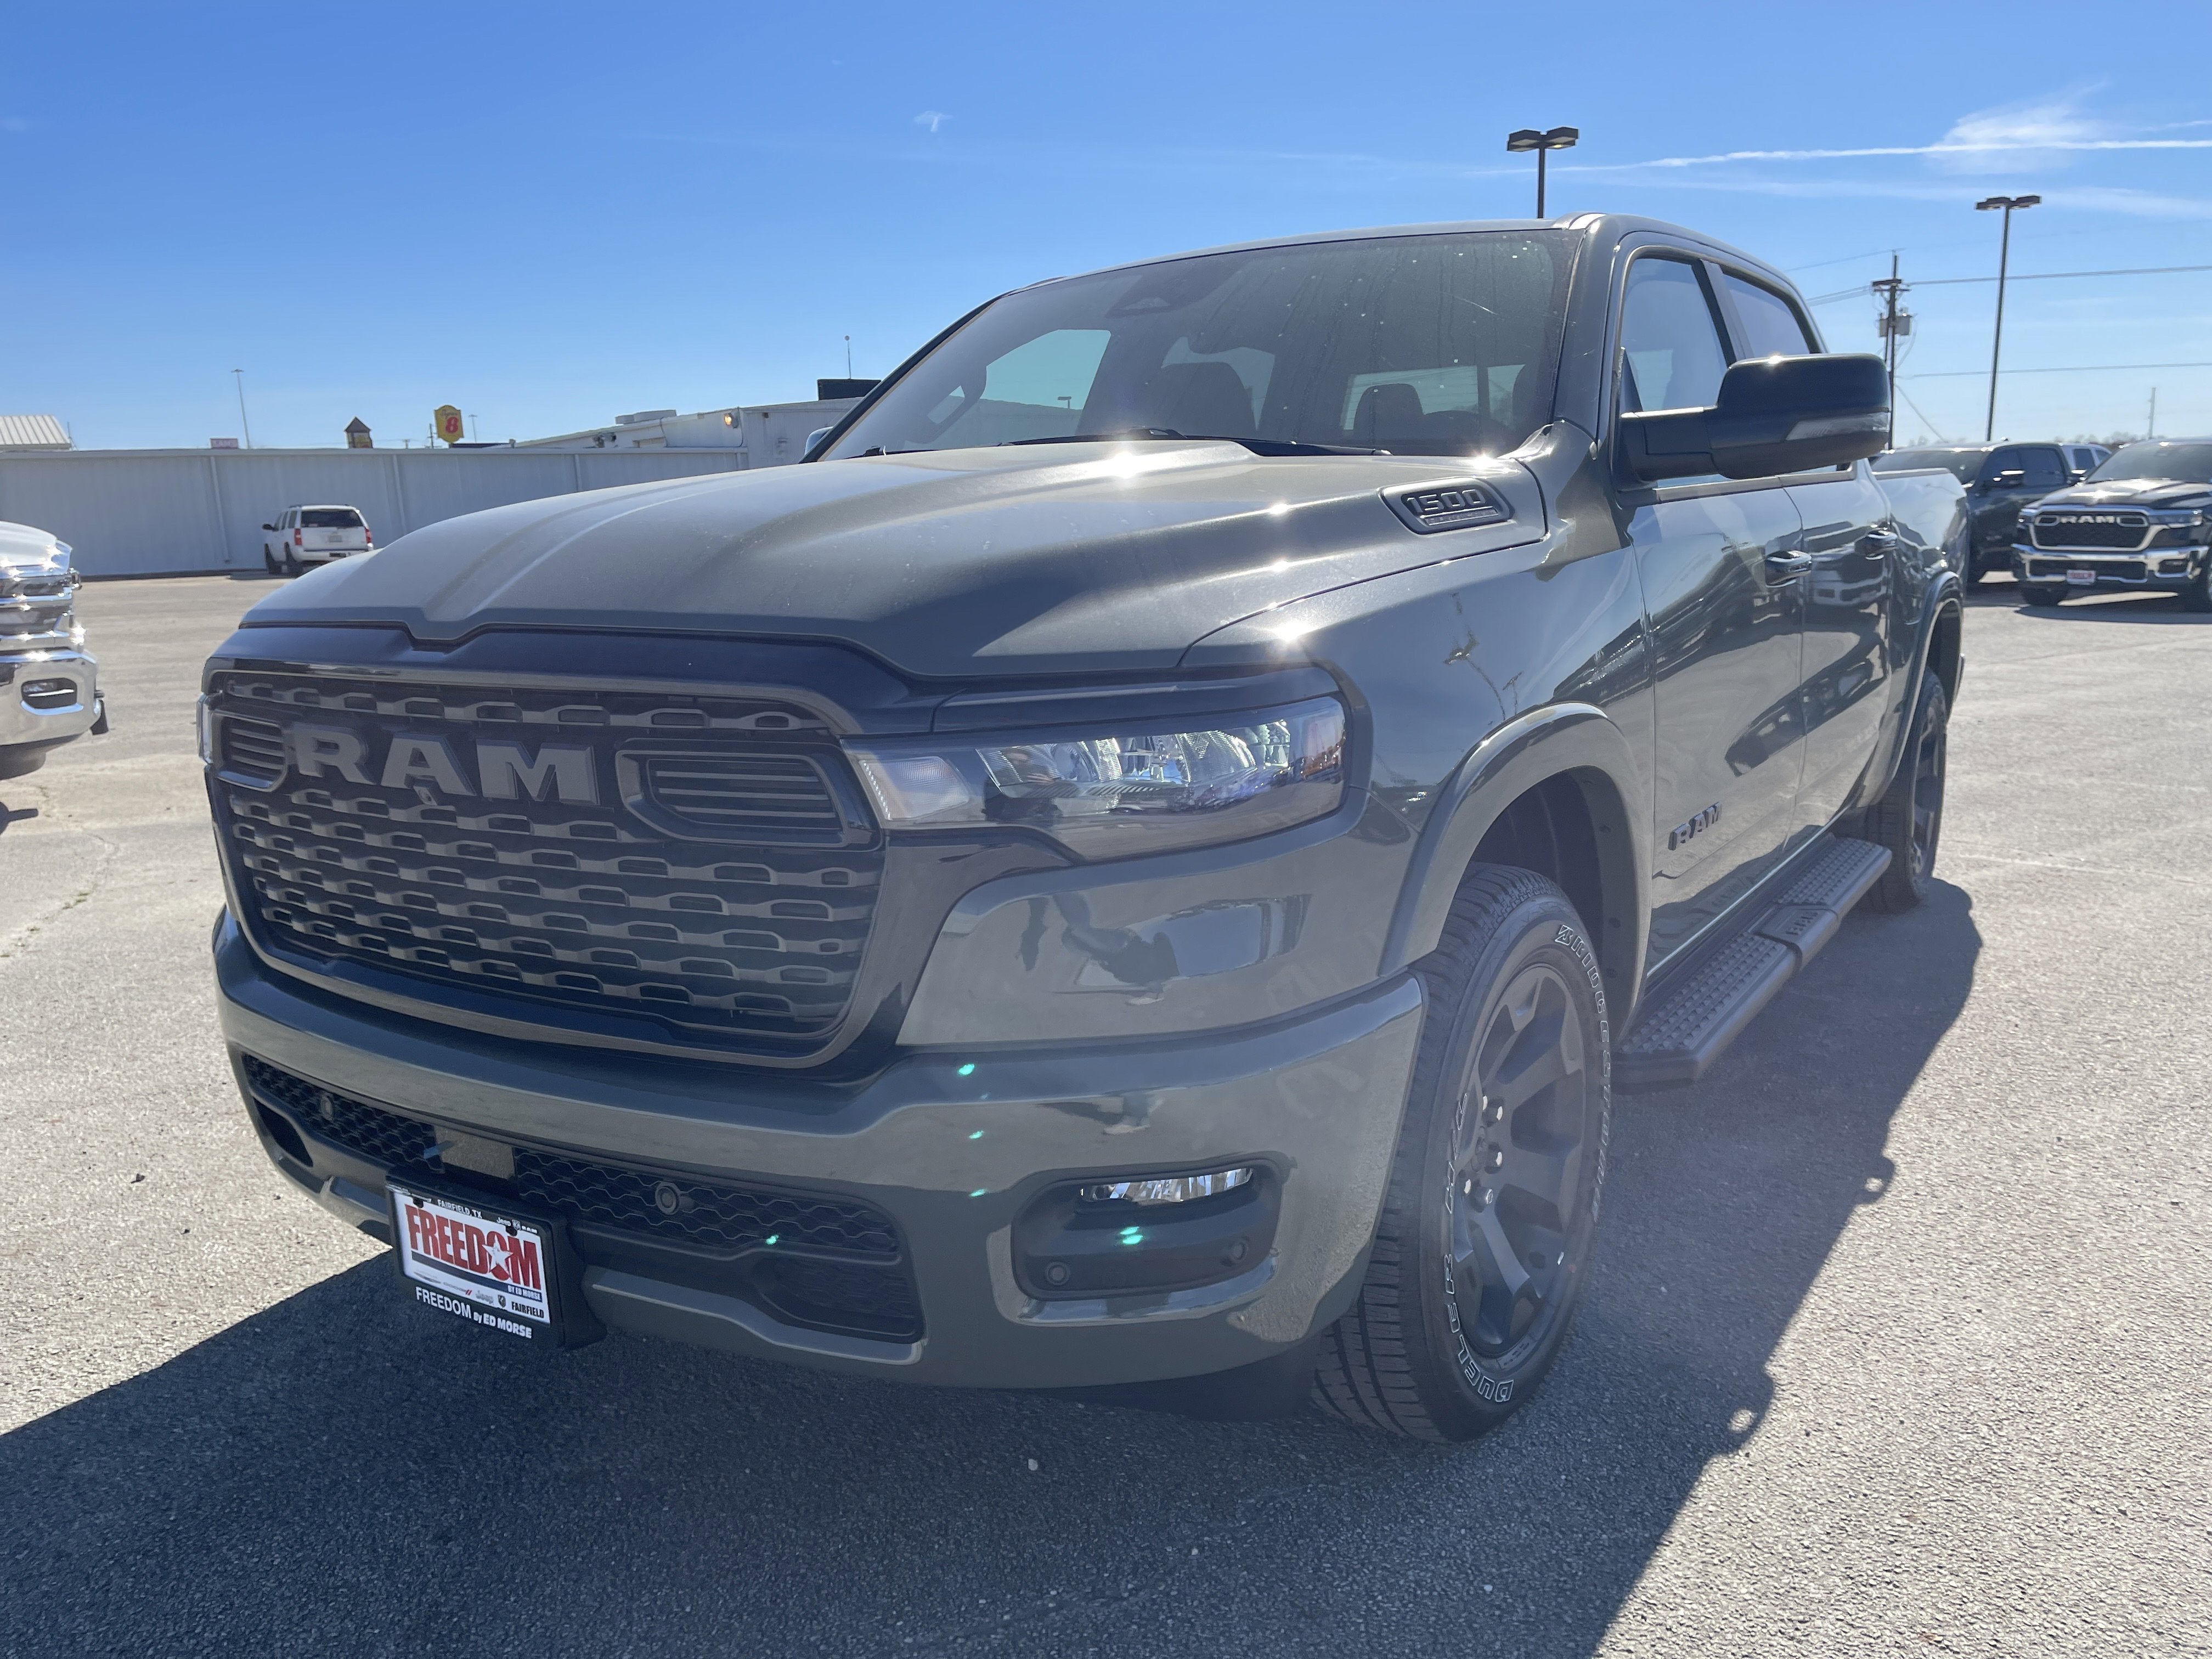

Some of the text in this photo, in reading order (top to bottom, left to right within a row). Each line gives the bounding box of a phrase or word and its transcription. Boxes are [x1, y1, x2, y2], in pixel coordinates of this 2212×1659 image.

[445, 416, 459, 433] 8
[1406, 489, 1486, 513] 1500
[292, 721, 600, 805] RAM
[1668, 802, 1722, 851] RAM
[1554, 924, 1611, 1222] BRIDGESTONE
[472, 1209, 482, 1218] TX
[405, 1204, 541, 1290] FREEDOM
[415, 1286, 472, 1319] FREEDOM
[483, 1313, 496, 1327] ED
[497, 1317, 532, 1339] MORSE
[511, 1301, 544, 1318] FAIRFIELD
[1443, 1254, 1514, 1403] DUELER
